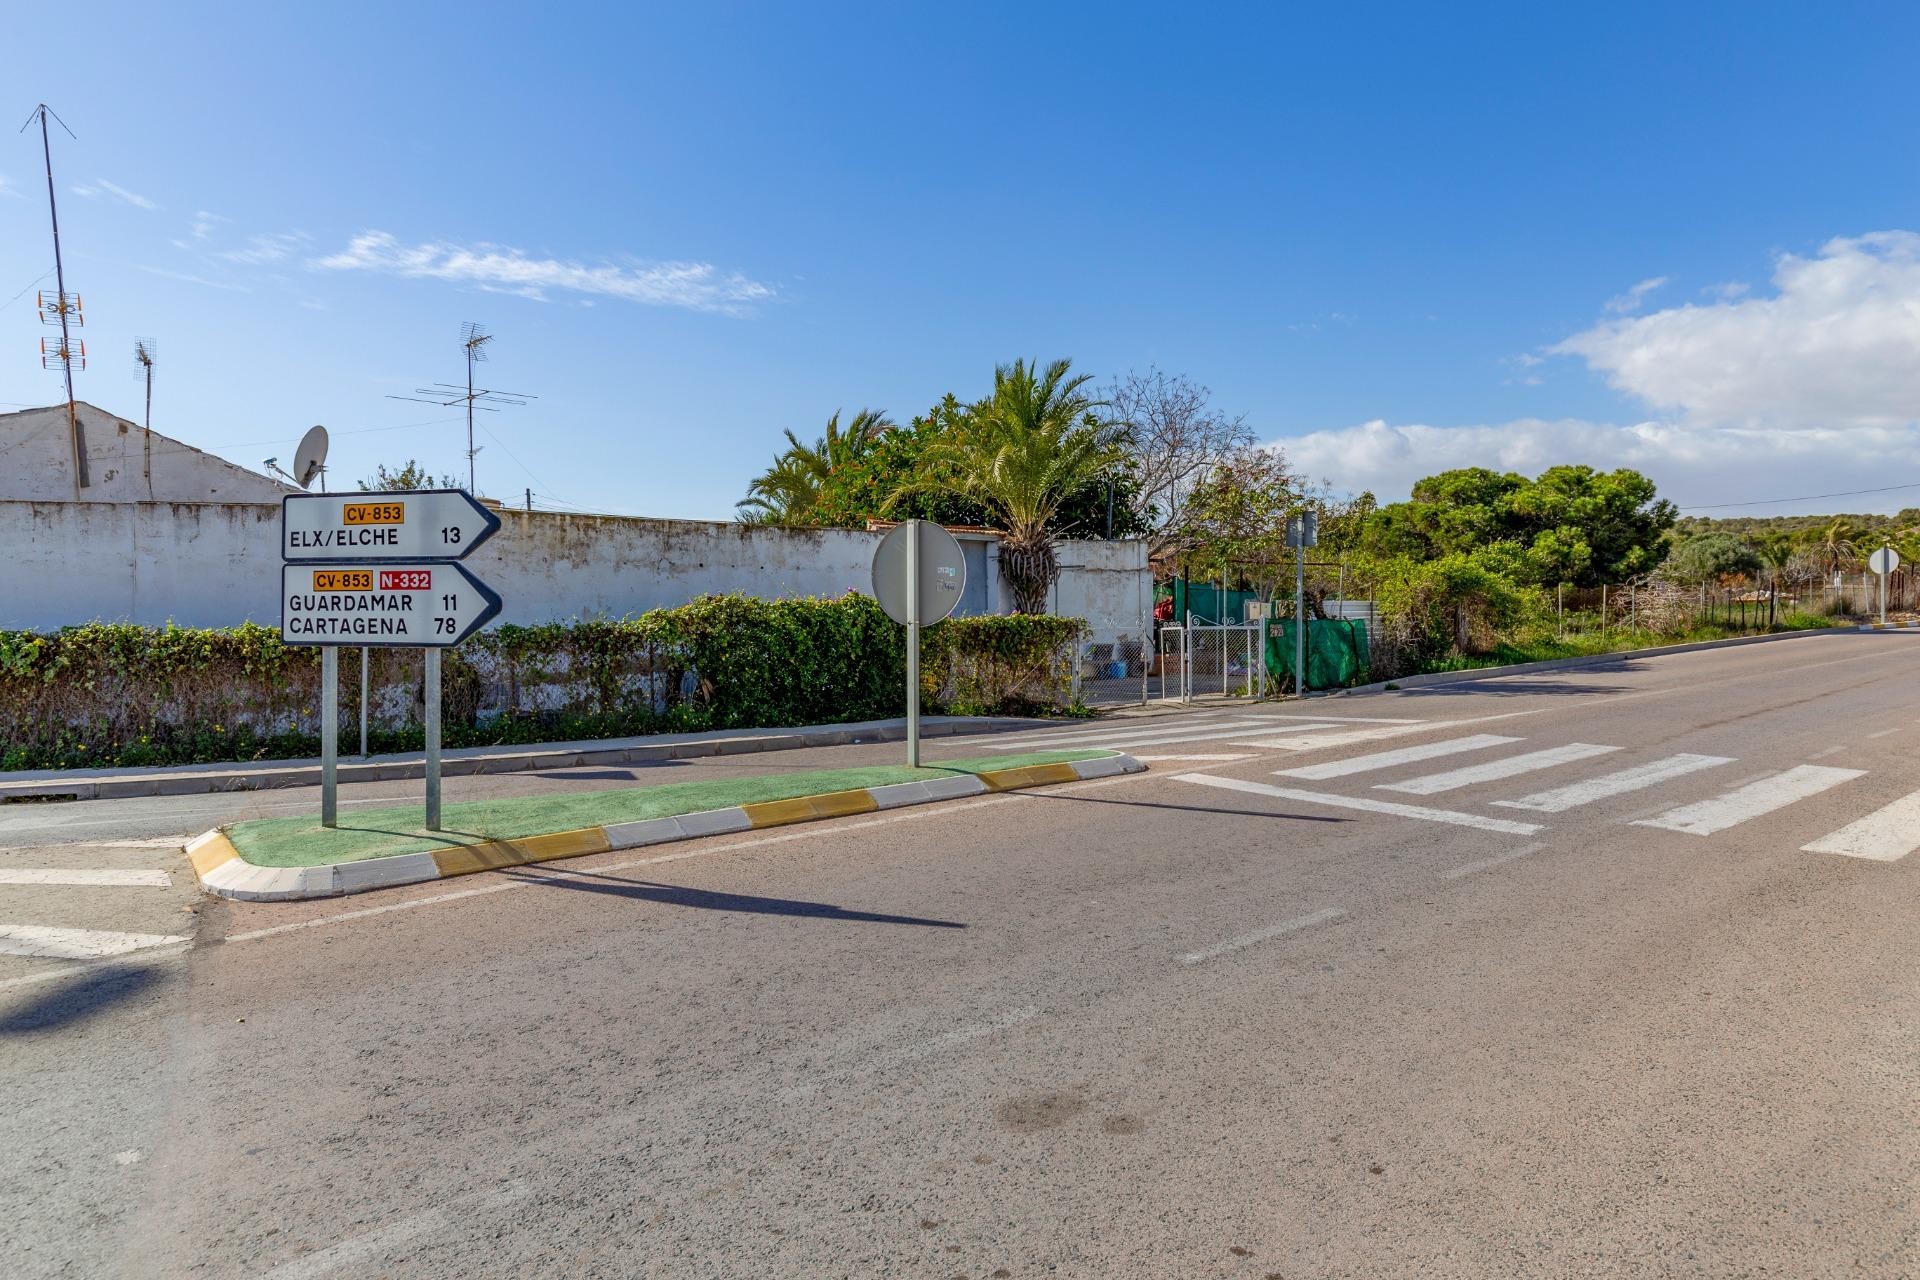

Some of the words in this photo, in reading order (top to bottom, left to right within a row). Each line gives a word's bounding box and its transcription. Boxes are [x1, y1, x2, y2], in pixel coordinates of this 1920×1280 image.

[347, 506, 401, 522] CV-853
[290, 528, 399, 547] ELX/ELCHE
[441, 527, 461, 544] 13
[316, 574, 370, 588] CV-853
[381, 573, 429, 588] N-332
[289, 594, 413, 612] GUARDAMAR
[442, 594, 457, 611] 11
[289, 617, 408, 635] CARTAGENA
[434, 617, 456, 635] 78
